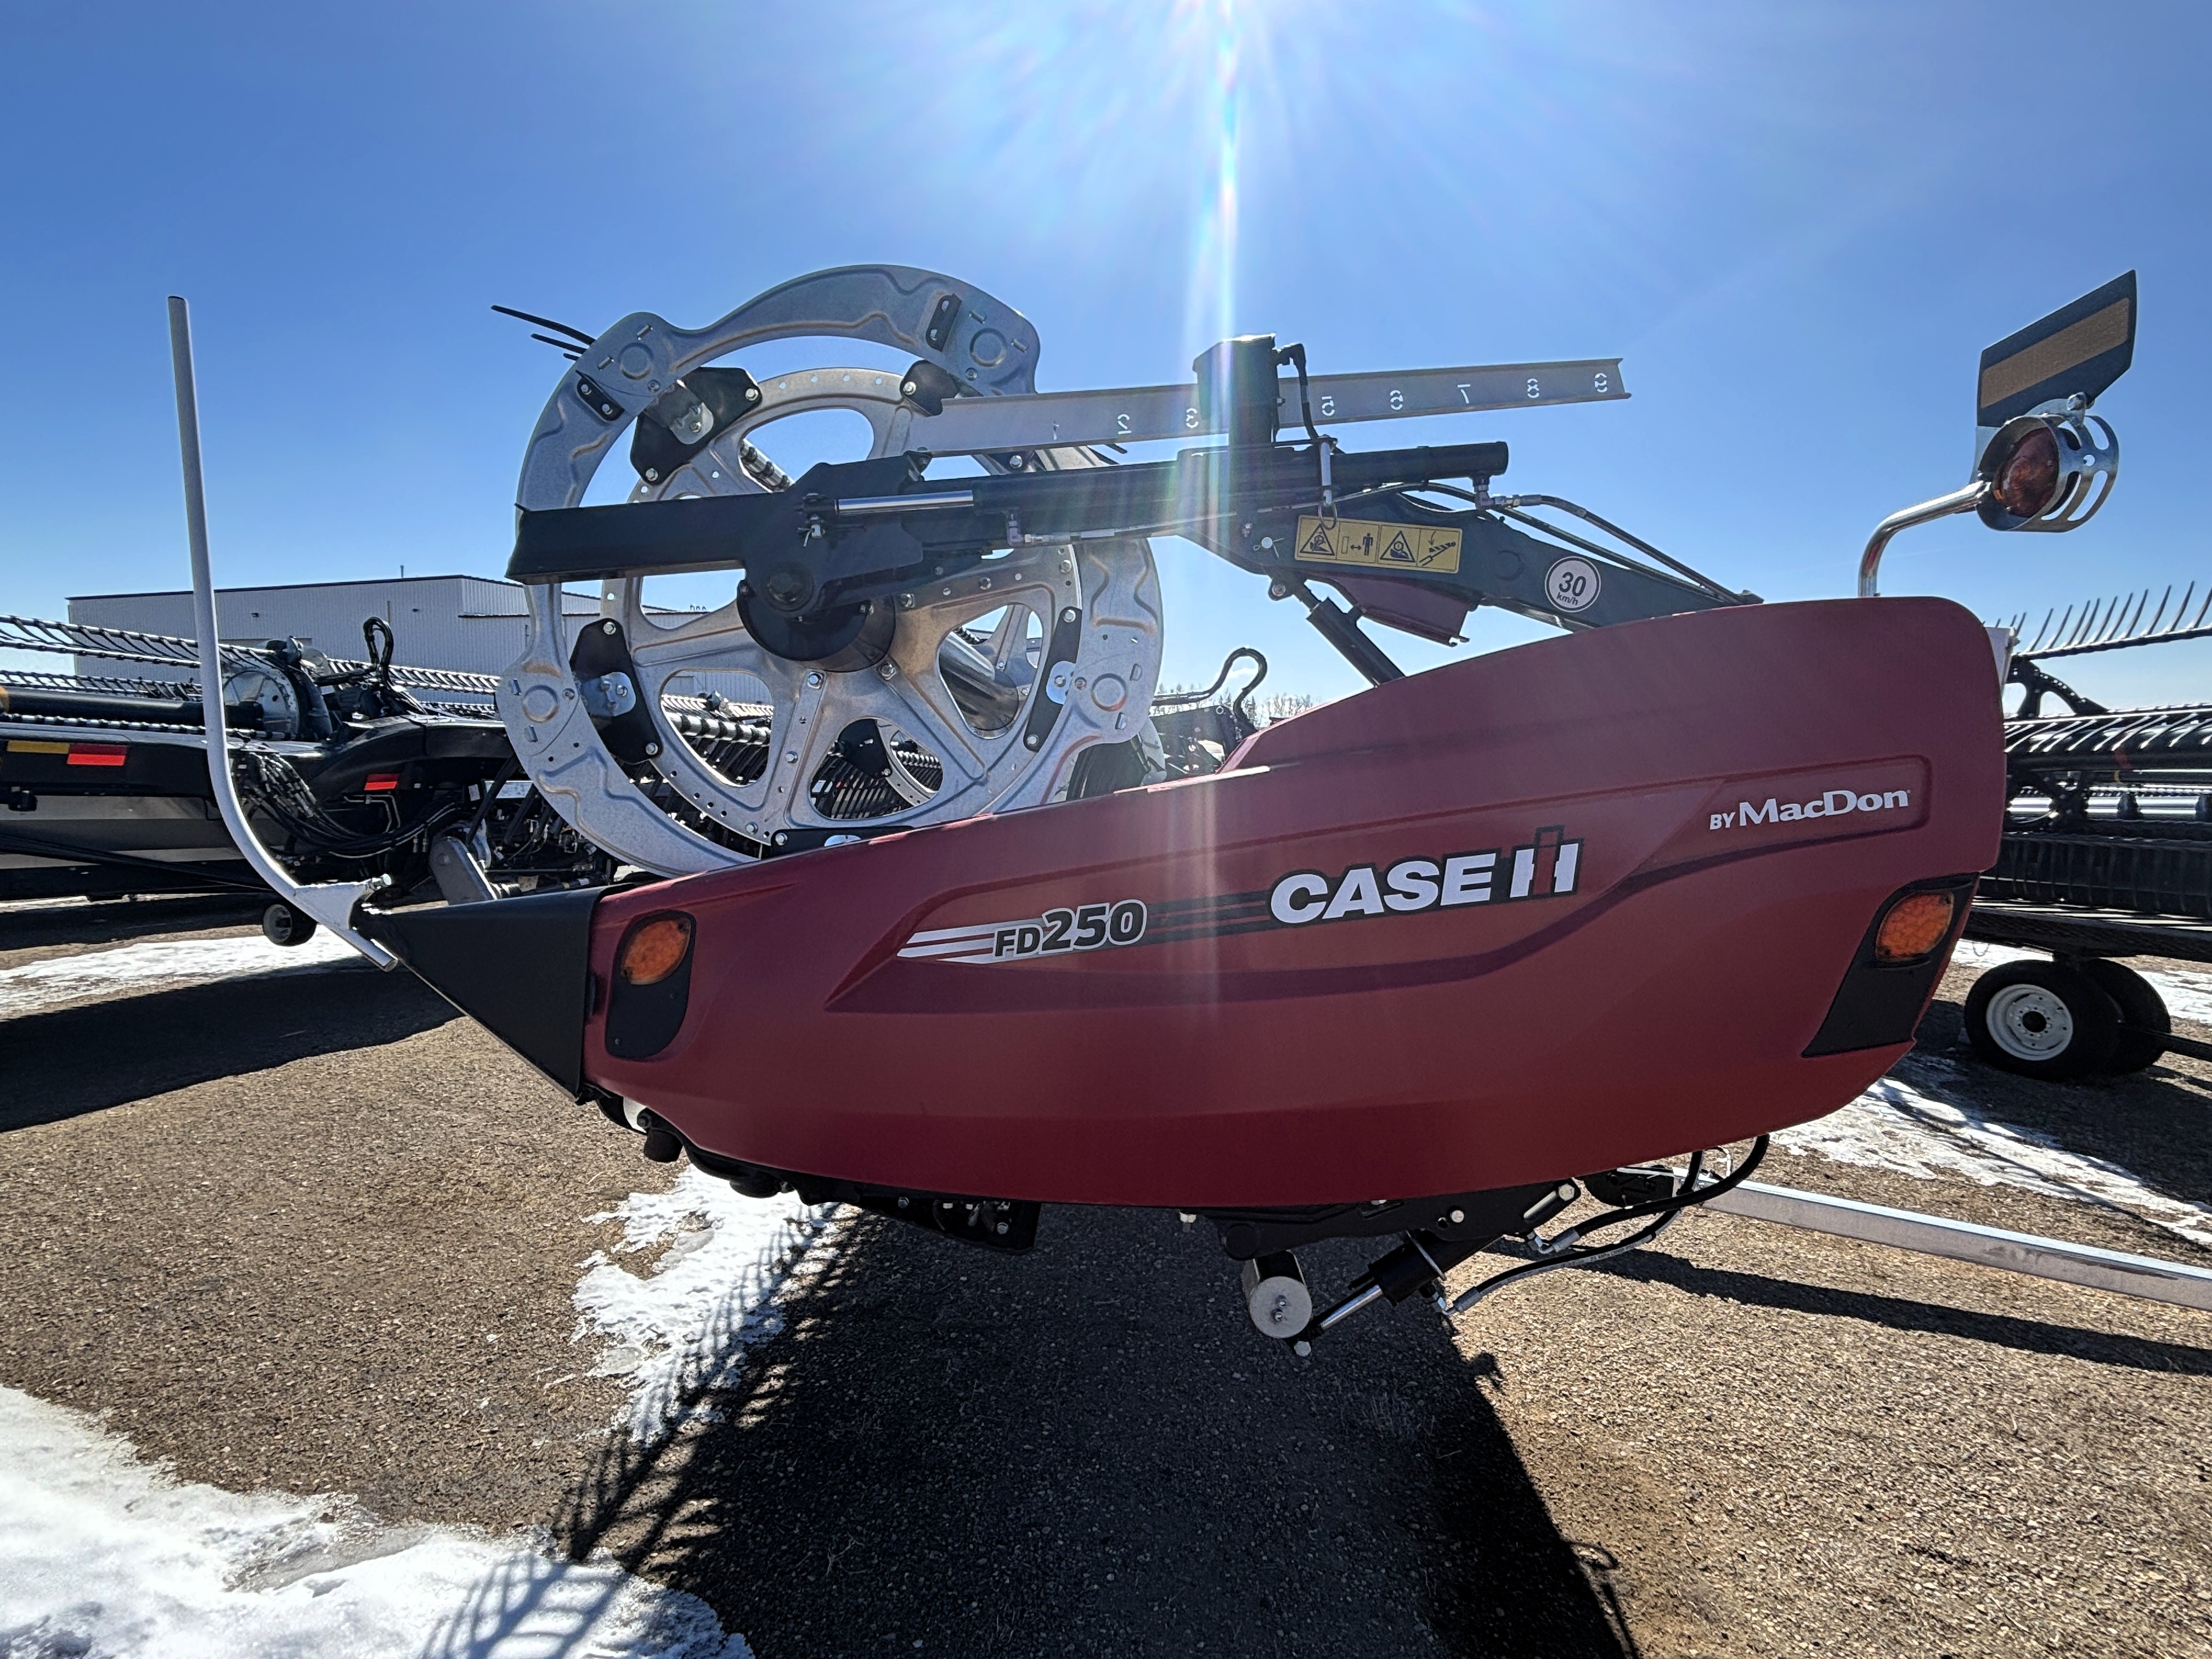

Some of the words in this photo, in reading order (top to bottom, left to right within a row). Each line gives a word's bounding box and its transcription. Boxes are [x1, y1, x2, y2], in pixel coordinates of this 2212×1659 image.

[1556, 592, 1579, 606] km/h
[1559, 572, 1587, 597] 30
[1709, 812, 1735, 830] BY
[1739, 789, 1910, 827] MacDon
[1271, 853, 1497, 924] CASE
[994, 900, 1147, 958] FD250
